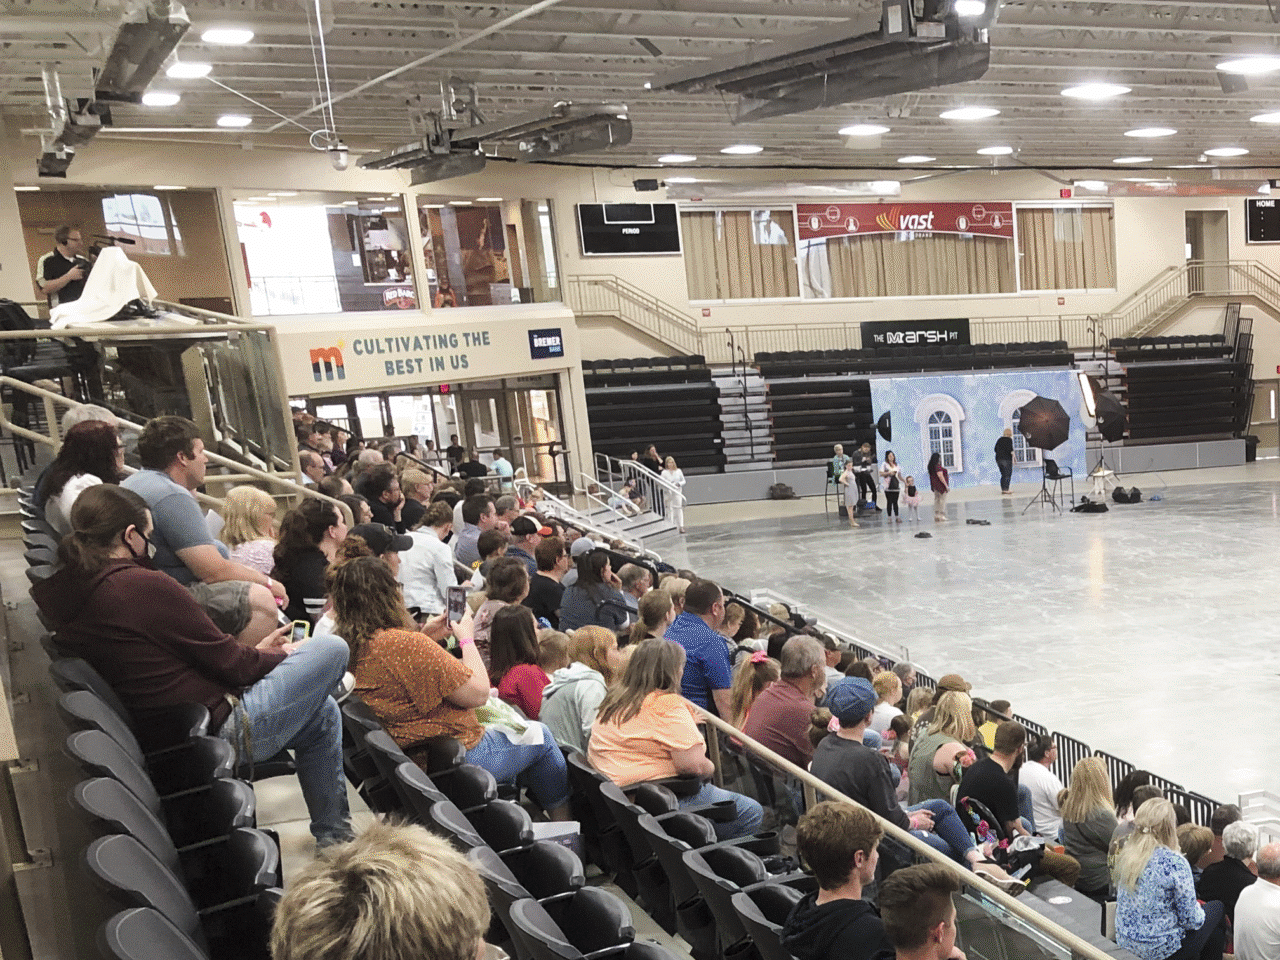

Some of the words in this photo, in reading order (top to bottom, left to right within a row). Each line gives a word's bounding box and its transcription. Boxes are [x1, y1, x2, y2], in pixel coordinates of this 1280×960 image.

[900, 211, 934, 230] vast
[353, 333, 458, 355] CULTIVATING
[462, 331, 490, 347] THE
[533, 336, 561, 348] BREMER
[874, 334, 884, 342] THE
[949, 331, 958, 340] PIT
[385, 358, 423, 376] BEST
[429, 356, 445, 372] IN
[450, 354, 469, 369] US
